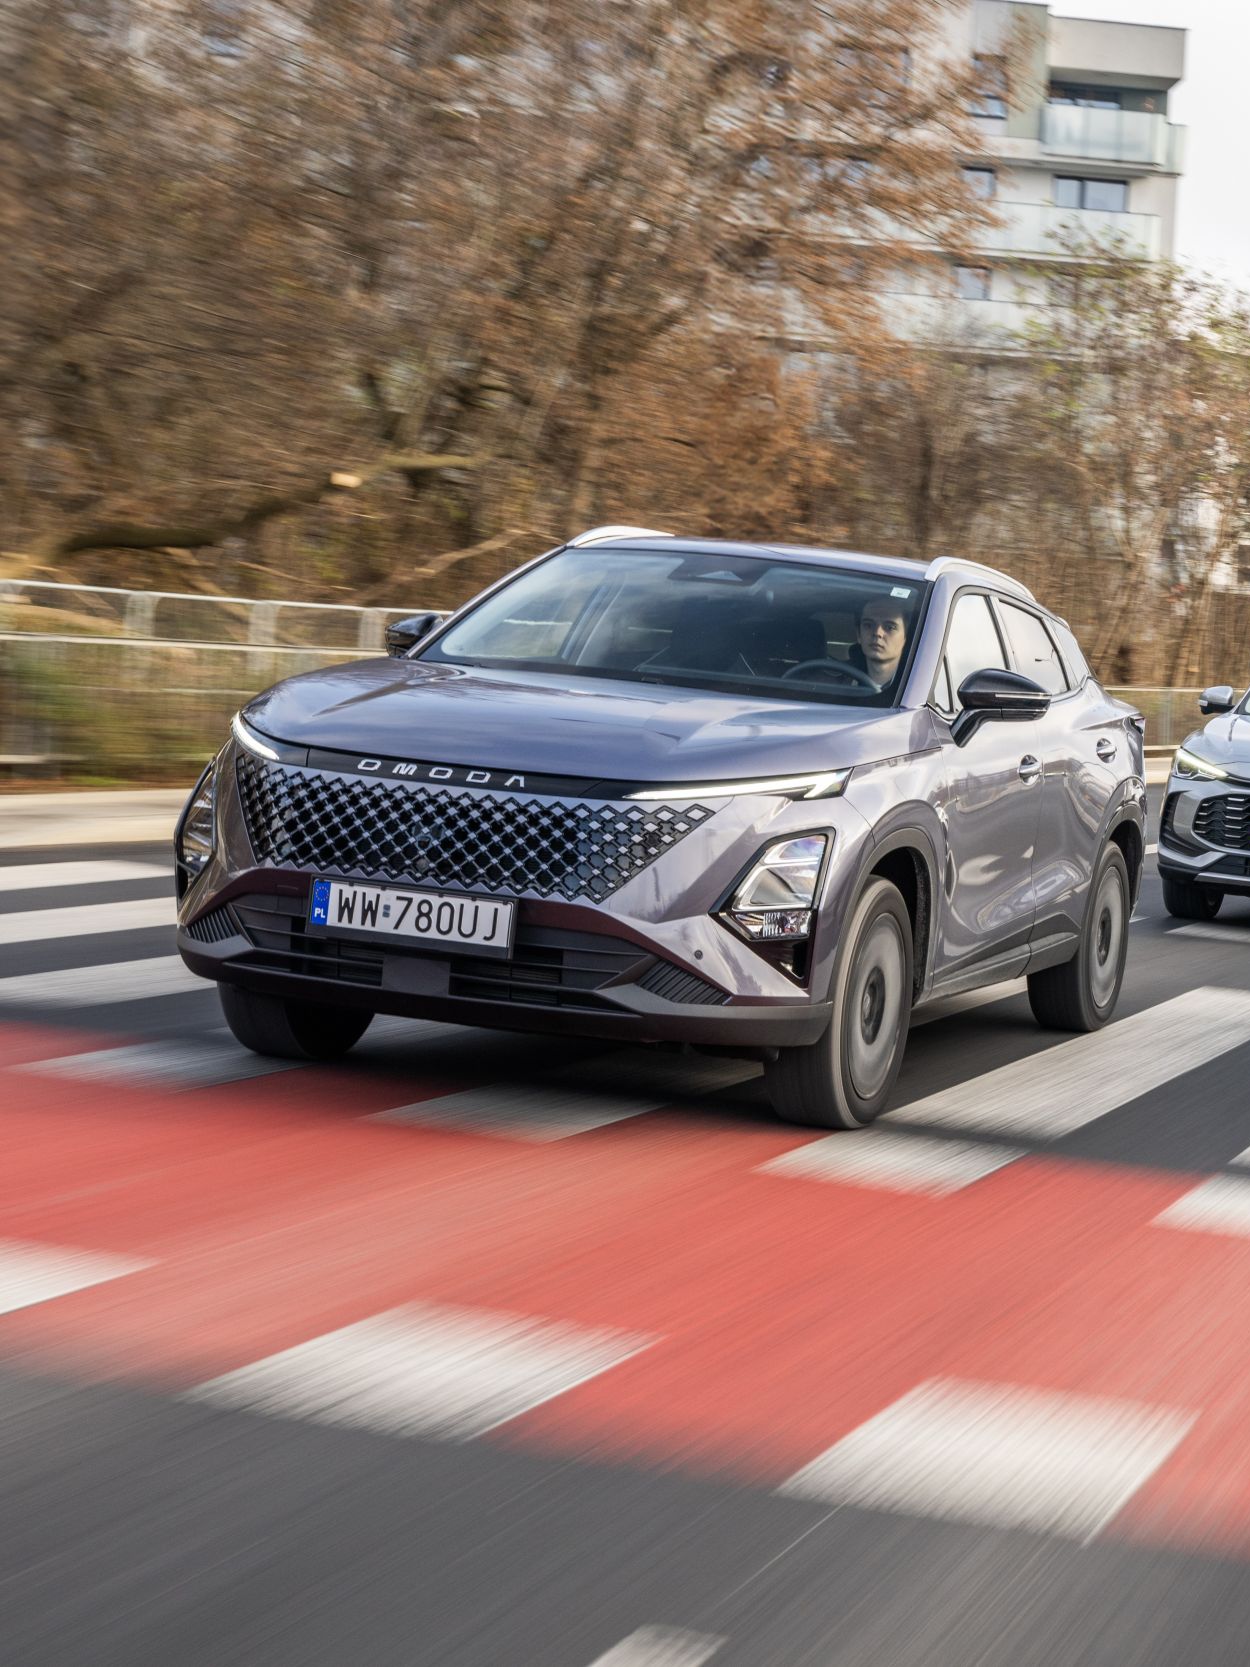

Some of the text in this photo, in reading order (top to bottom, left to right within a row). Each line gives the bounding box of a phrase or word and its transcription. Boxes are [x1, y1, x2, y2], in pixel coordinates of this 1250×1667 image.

[357, 759, 525, 788] OMODA
[314, 907, 326, 919] PL
[337, 888, 498, 942] WW 780UJ
